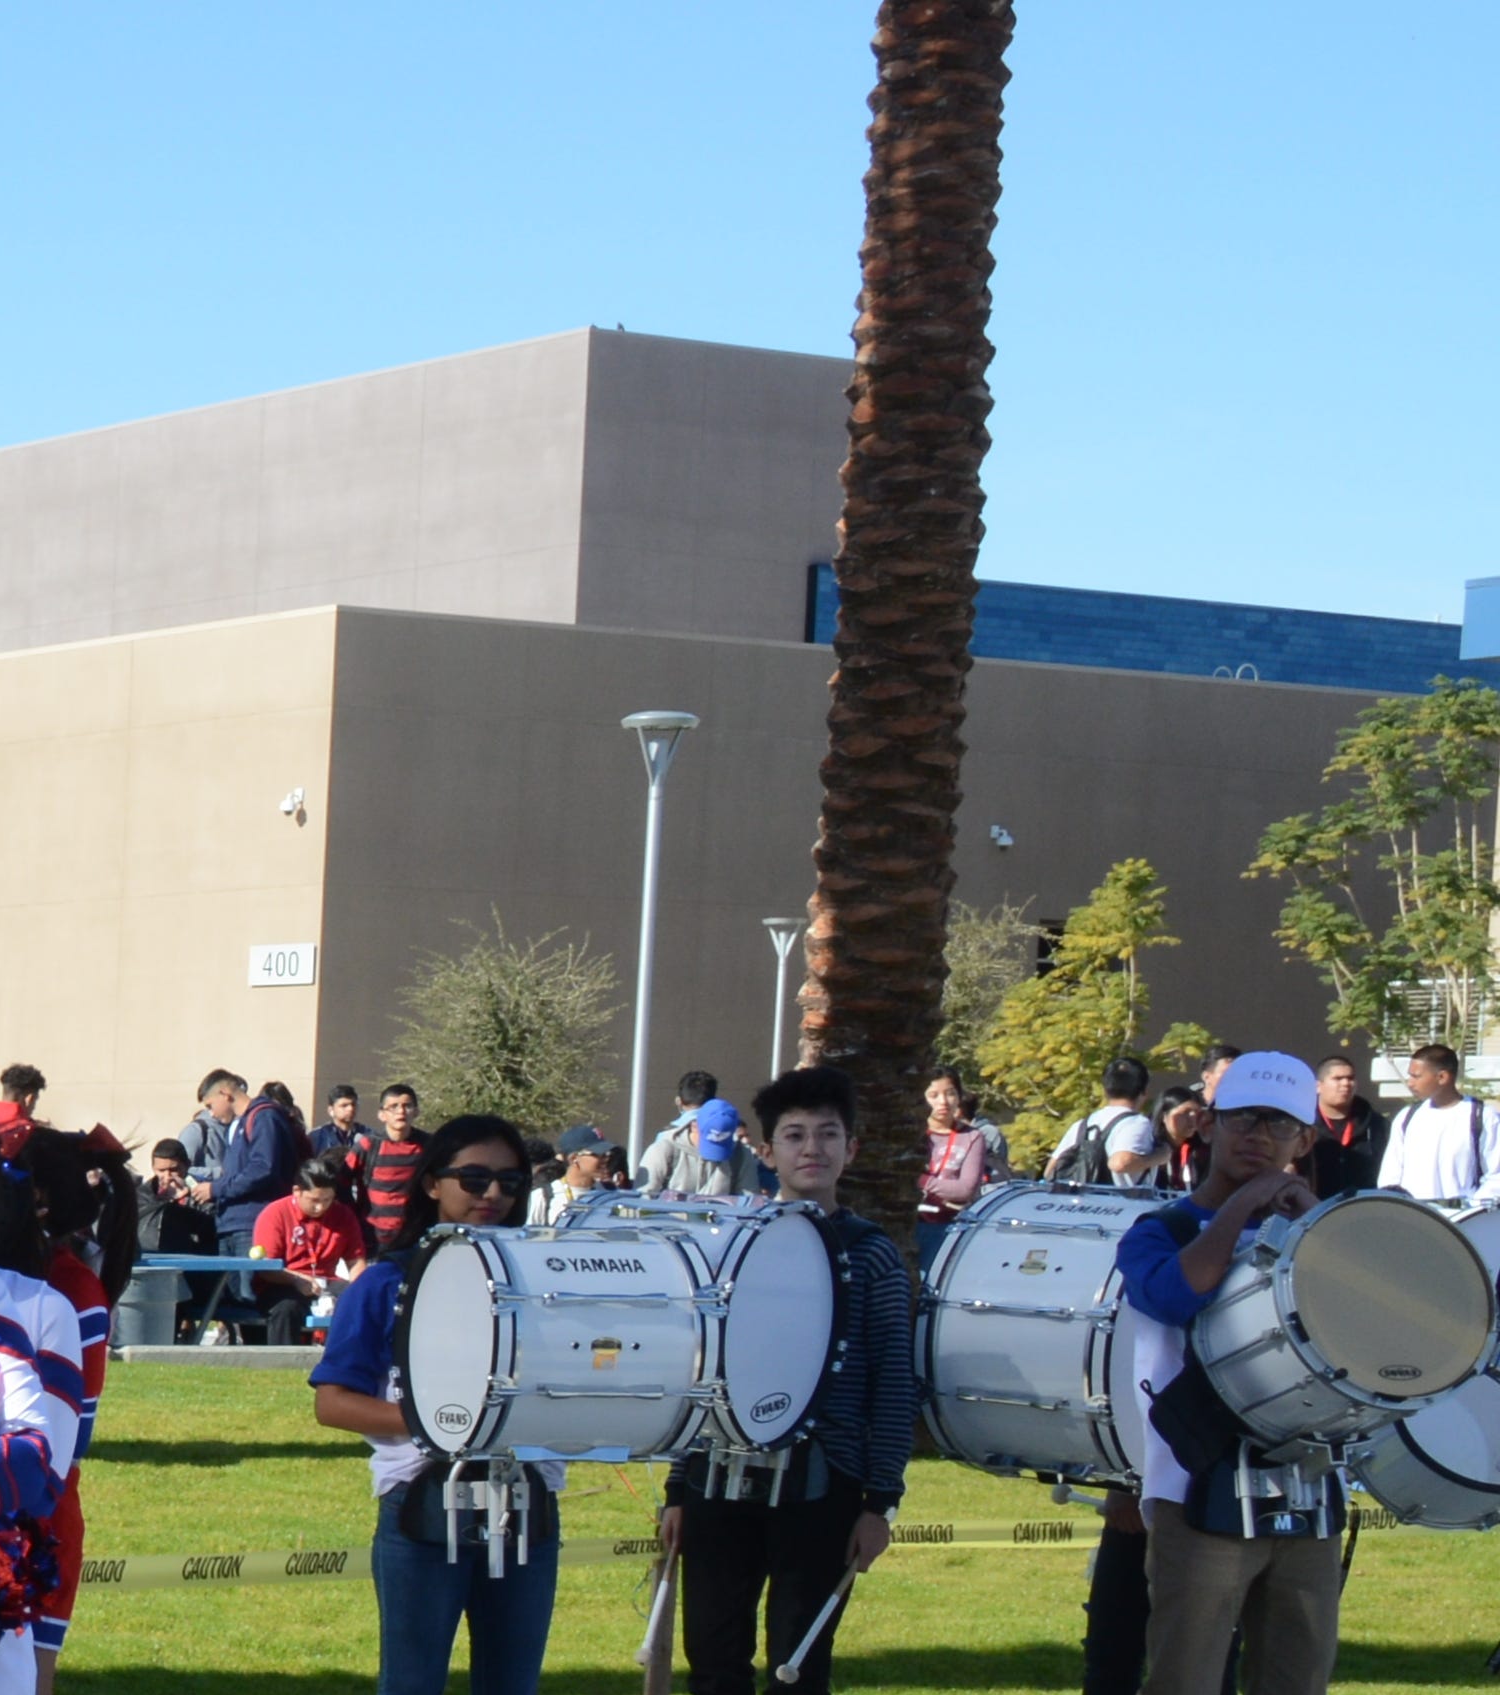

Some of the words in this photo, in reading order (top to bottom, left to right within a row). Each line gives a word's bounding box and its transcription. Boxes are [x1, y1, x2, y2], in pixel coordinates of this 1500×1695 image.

[262, 951, 299, 977] 400
[1056, 1204, 1124, 1217] YAMAHA
[567, 1258, 647, 1273] YAMAHA
[755, 1397, 786, 1418] EVANS
[439, 1412, 468, 1426] EVANS
[1274, 1514, 1292, 1530] M
[1013, 1522, 1073, 1543] CAUTION
[81, 1559, 126, 1583] IDADO
[182, 1556, 244, 1580] CAUTION
[285, 1551, 345, 1576] CUIDADO
